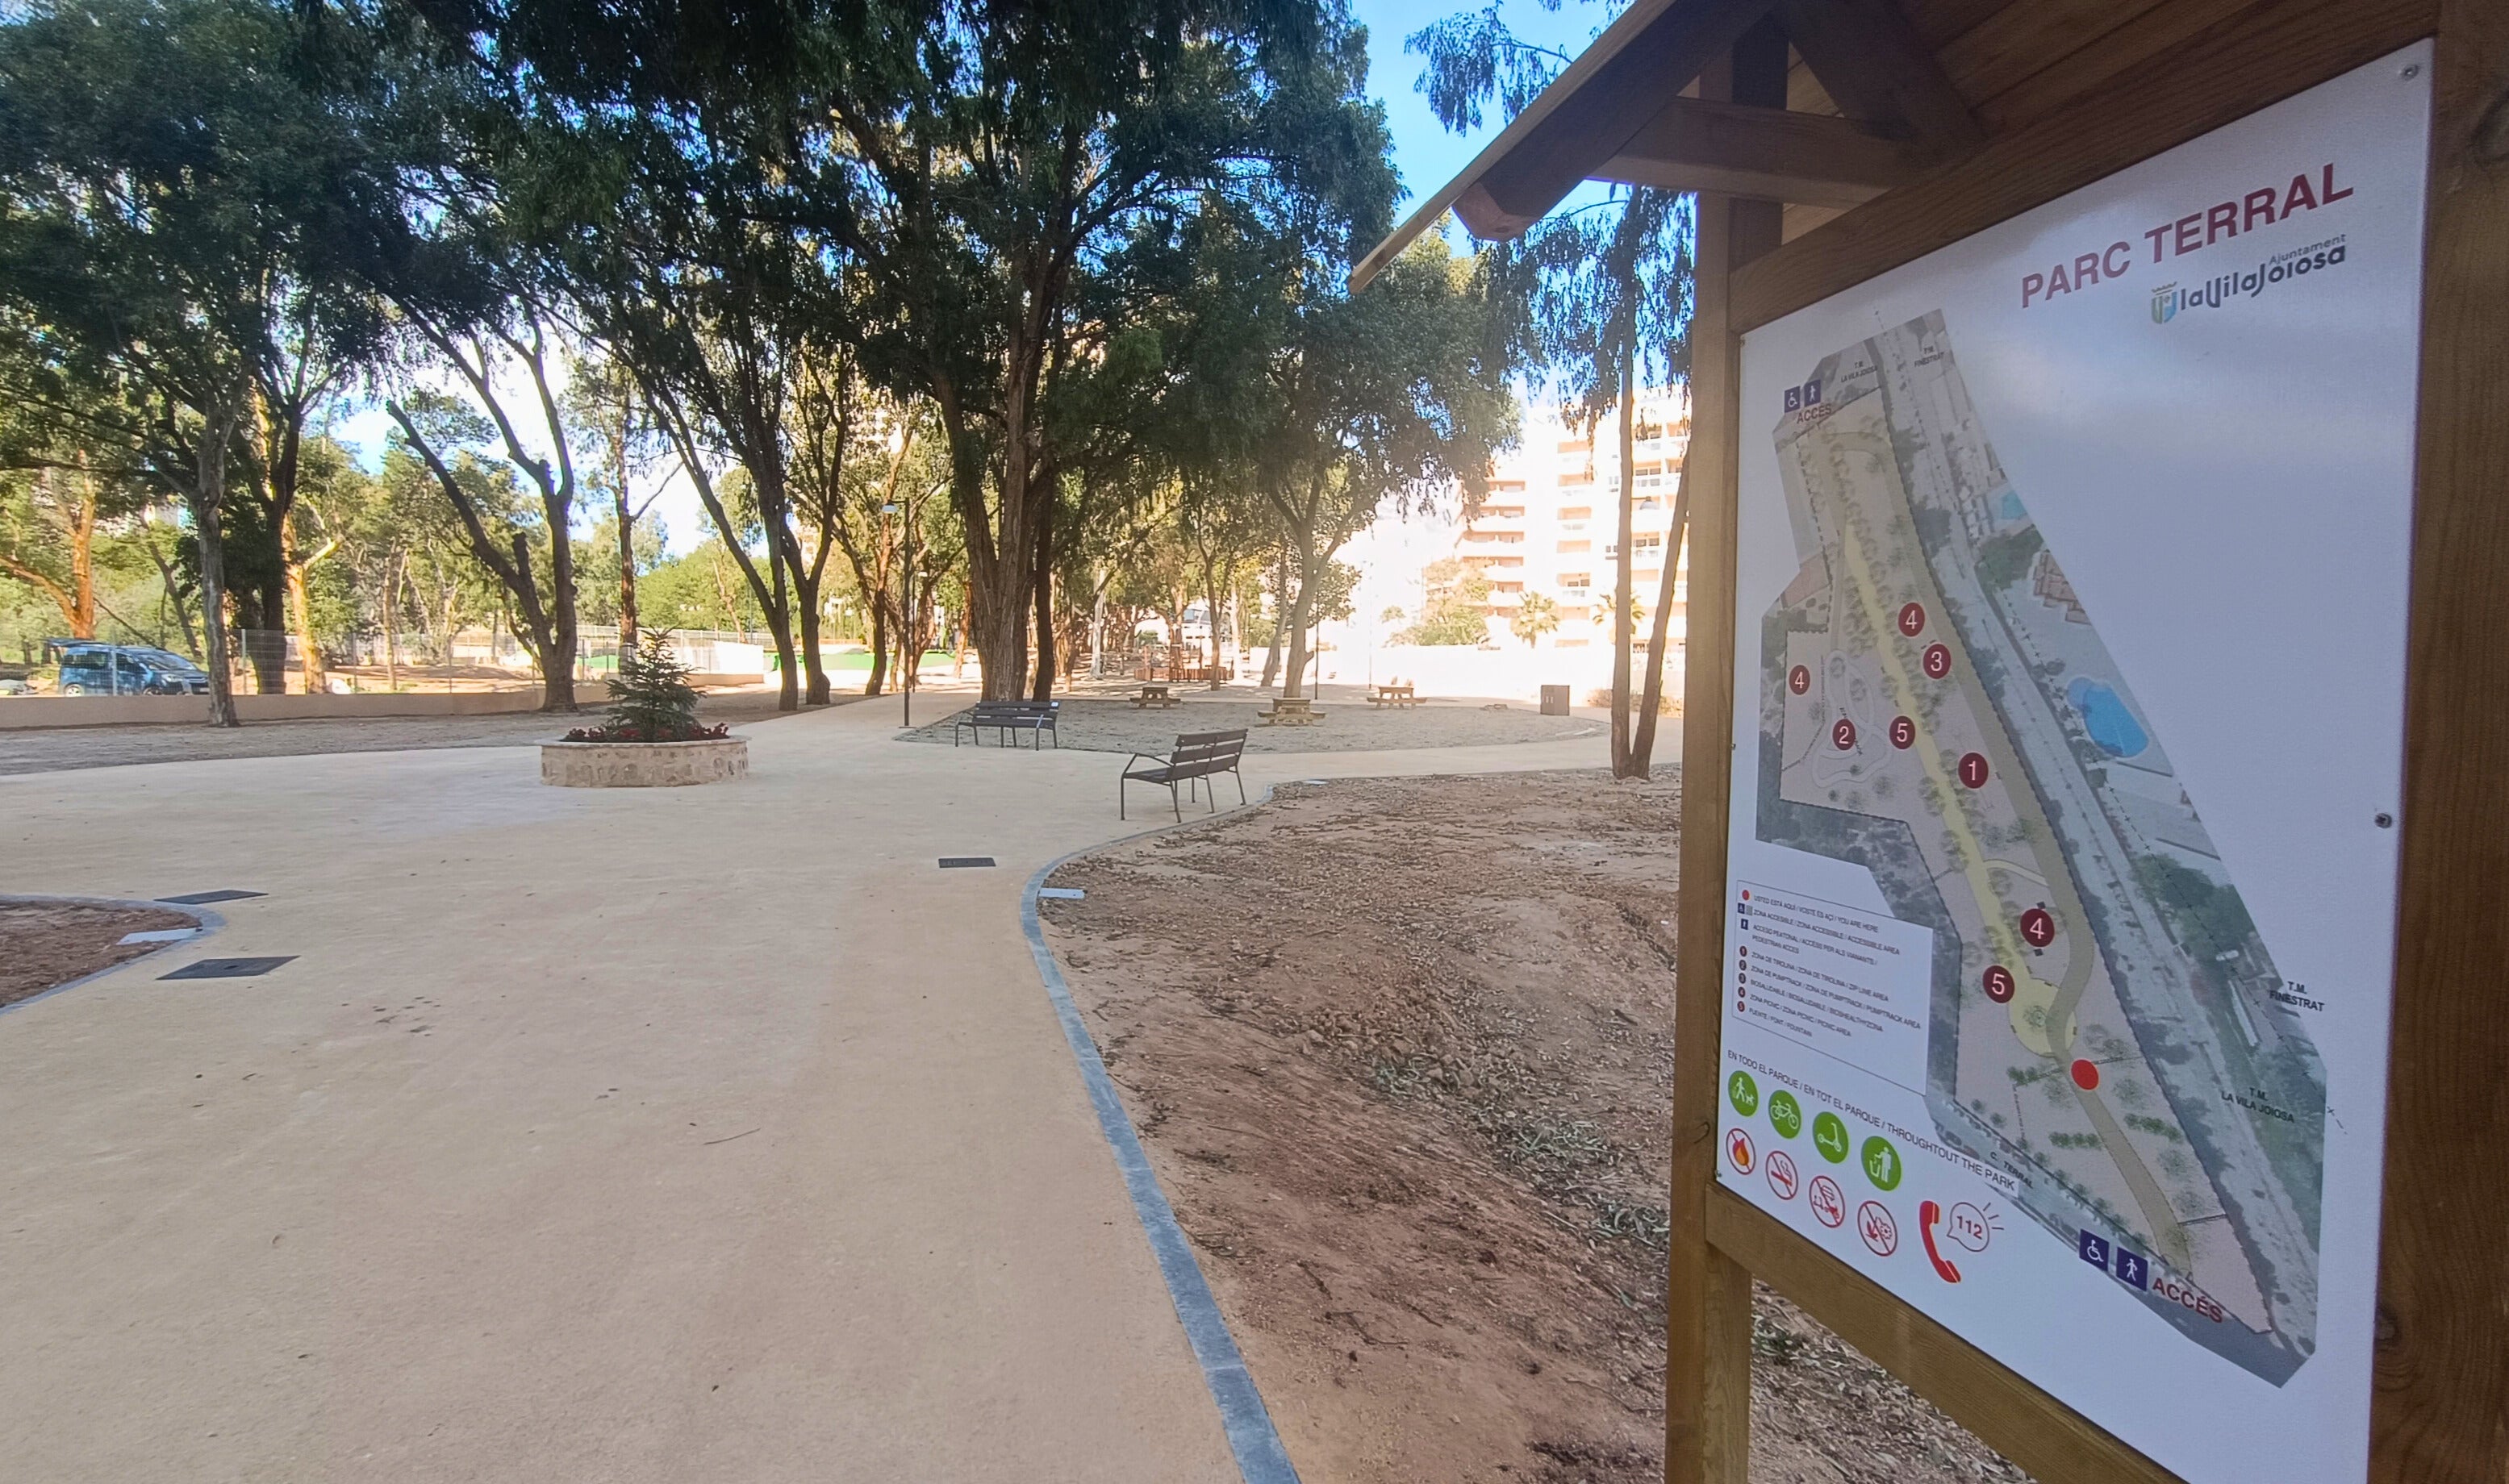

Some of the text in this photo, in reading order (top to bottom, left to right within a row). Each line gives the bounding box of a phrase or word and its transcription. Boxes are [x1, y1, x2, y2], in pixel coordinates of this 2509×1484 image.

[2023, 163, 2354, 308] PARC TERRAL
[2269, 234, 2347, 265] Ajuntament
[1906, 610, 1918, 629] 4
[1931, 651, 1942, 671] 3
[1795, 671, 1804, 688] 4
[1839, 726, 1849, 744] 2
[1896, 723, 1907, 742] 5
[1968, 761, 1977, 781] 1
[2029, 917, 2045, 940] 4
[1991, 973, 2006, 995] 5
[2286, 980, 2307, 994] T.M.
[2269, 990, 2325, 1012] FINESTRAT
[2249, 1087, 2269, 1101] T.M.
[2221, 1090, 2295, 1123] LA VILA JOIOSA
[1727, 1050, 1737, 1061] EN
[1739, 1054, 1757, 1069] TODO
[1759, 1064, 1768, 1074] EL
[1768, 1068, 1799, 1089] PARQUE
[1804, 1084, 1814, 1096] EN
[1816, 1090, 1833, 1103] TOT
[1834, 1098, 1844, 1111] EL
[1845, 1103, 1881, 1128] PARQUE
[1887, 1123, 1960, 1164] THROUGHTOUT
[1961, 1157, 1983, 1176] THE
[1985, 1168, 2015, 1190] PARK
[2003, 1161, 2035, 1190] TERRAL
[1956, 1215, 1983, 1240] 112
